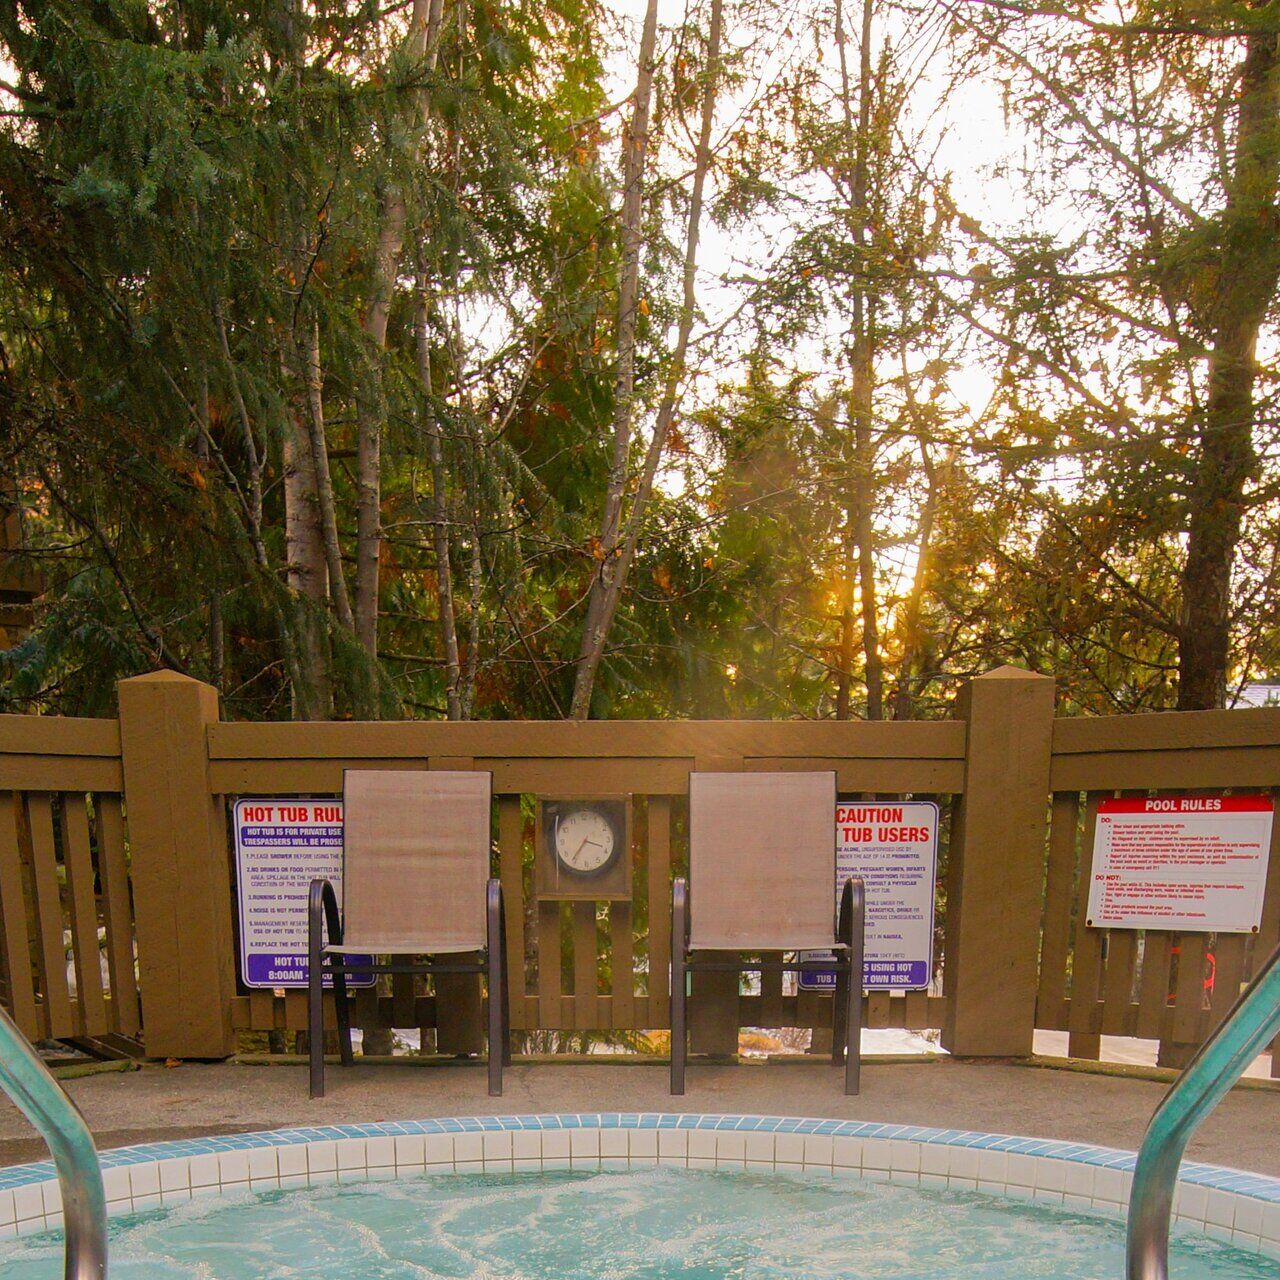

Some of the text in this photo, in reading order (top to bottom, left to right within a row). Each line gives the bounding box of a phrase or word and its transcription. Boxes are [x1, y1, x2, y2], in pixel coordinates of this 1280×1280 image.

[1145, 799, 1221, 811] POOL RULES
[243, 807, 343, 823] HOT TUB RUL
[836, 808, 903, 823] CAUTION
[247, 828, 341, 836] HOT TUB IS FOR PRIVATE USE
[843, 827, 929, 842] TUB USERS
[244, 838, 342, 846] TRESPASSERS WILL BE PROSE
[274, 957, 292, 966] HOT
[871, 963, 895, 972] USING
[897, 963, 913, 972] HOT
[268, 971, 304, 980] 8:00AM
[816, 975, 832, 984] TUB
[870, 975, 890, 984] OWN
[891, 975, 912, 984] RISK.
